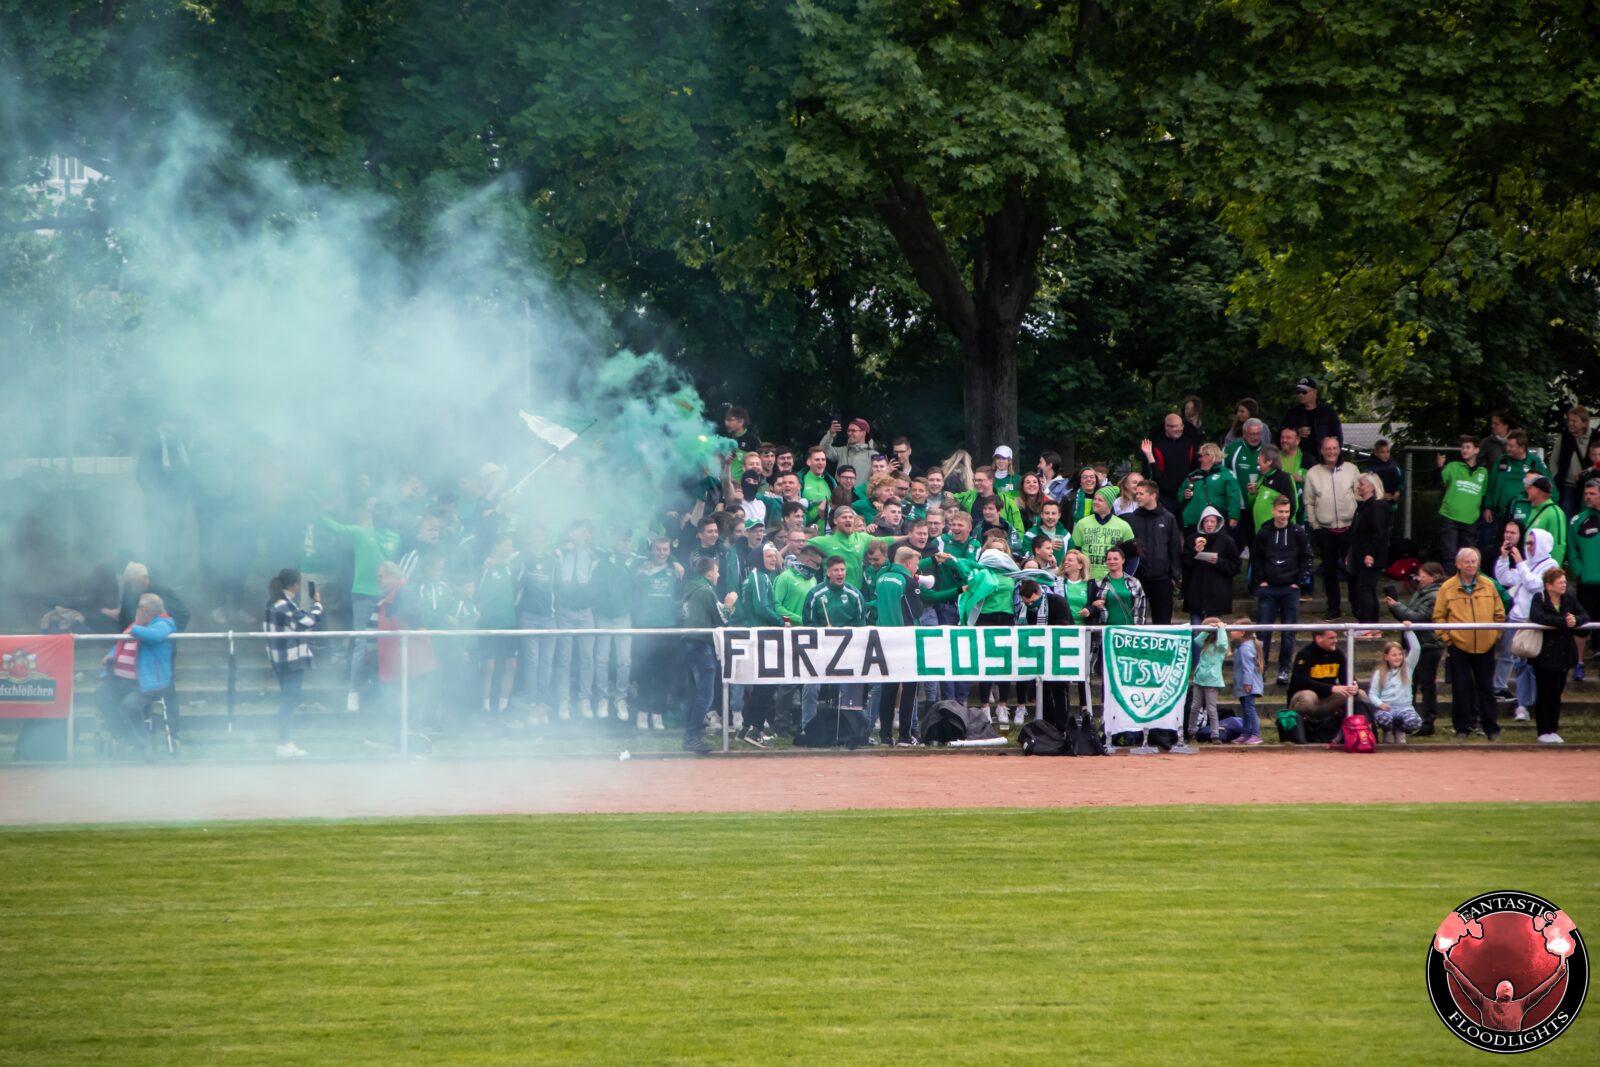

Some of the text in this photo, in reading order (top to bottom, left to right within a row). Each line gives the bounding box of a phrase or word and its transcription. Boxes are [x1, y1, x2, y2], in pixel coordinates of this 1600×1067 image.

[1102, 527, 1121, 537] DAVID
[723, 628, 1080, 678] FORZA COSSE
[1114, 635, 1176, 651] DRESDEN
[1117, 656, 1172, 685] TSV
